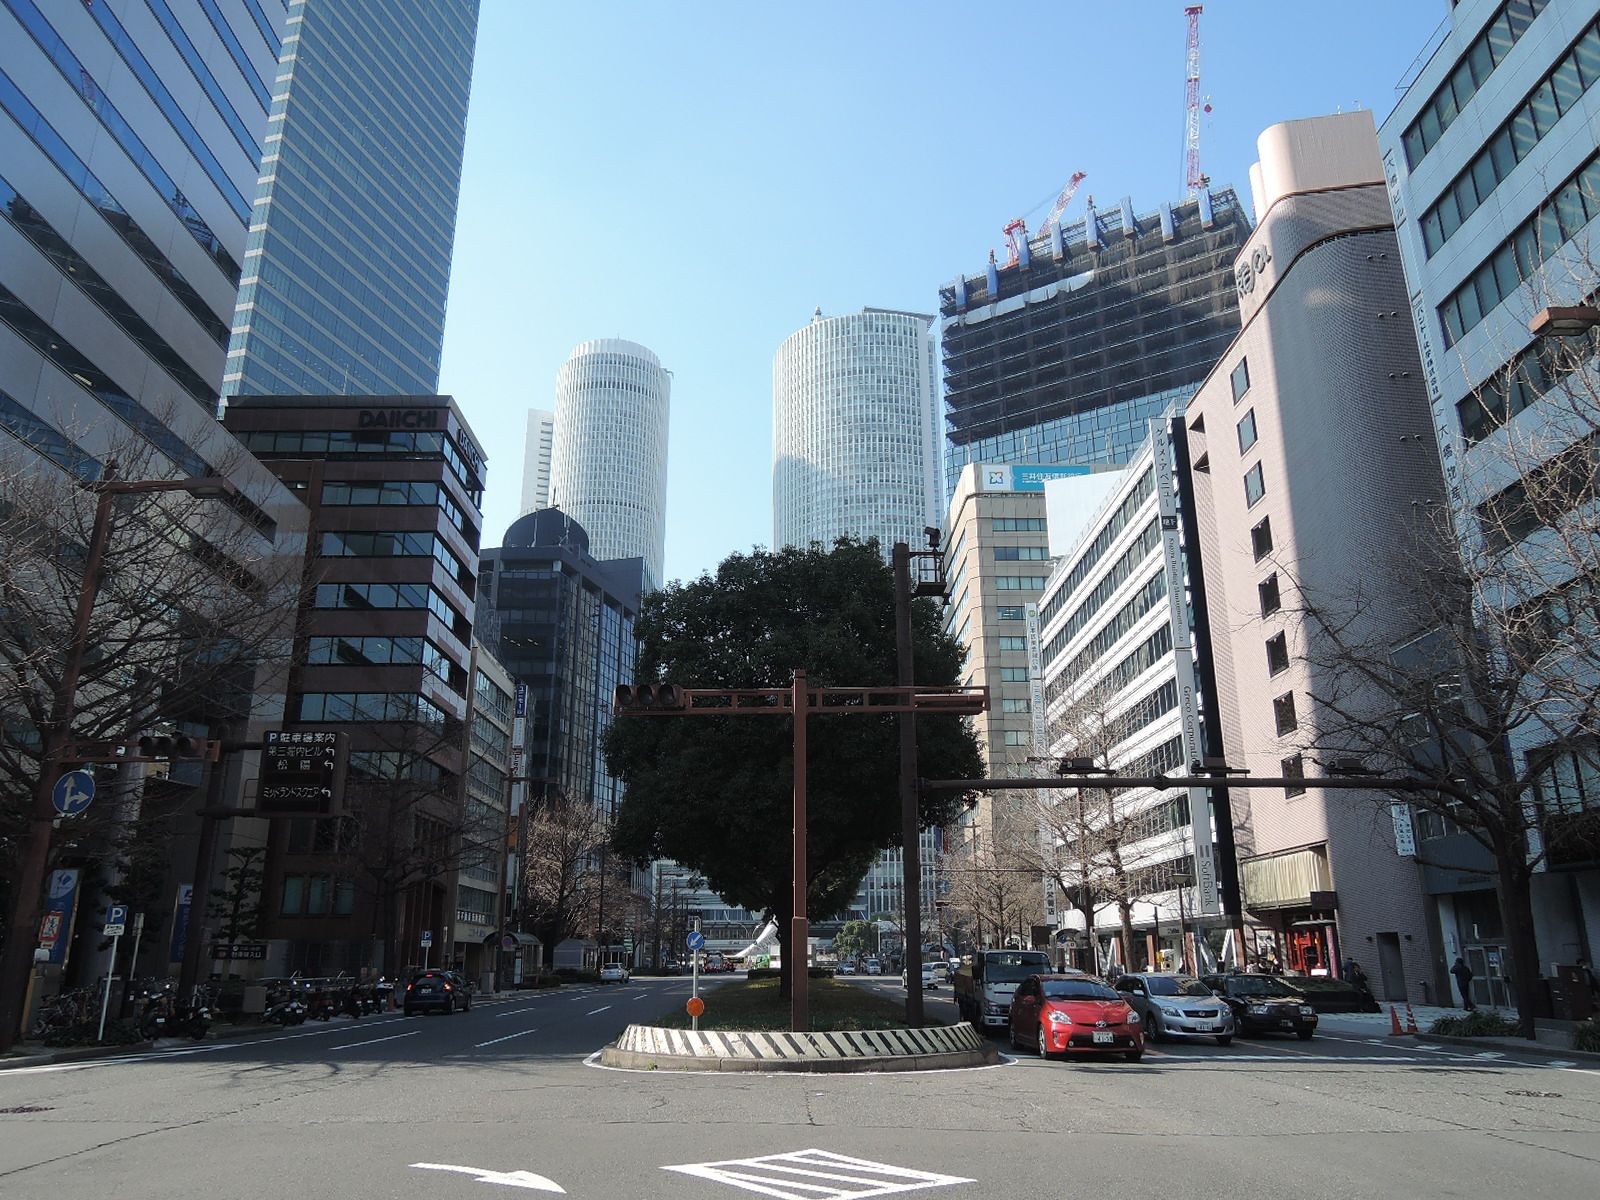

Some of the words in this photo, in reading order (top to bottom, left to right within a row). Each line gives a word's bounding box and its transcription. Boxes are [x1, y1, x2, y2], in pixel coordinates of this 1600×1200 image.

[359, 410, 437, 429] DAIICHI
[1156, 428, 1172, 508] グルメ・アベニュー
[269, 732, 278, 742] P
[280, 732, 336, 743] 駐車場案内
[1202, 860, 1214, 907] SoftBank
[110, 907, 124, 923] P
